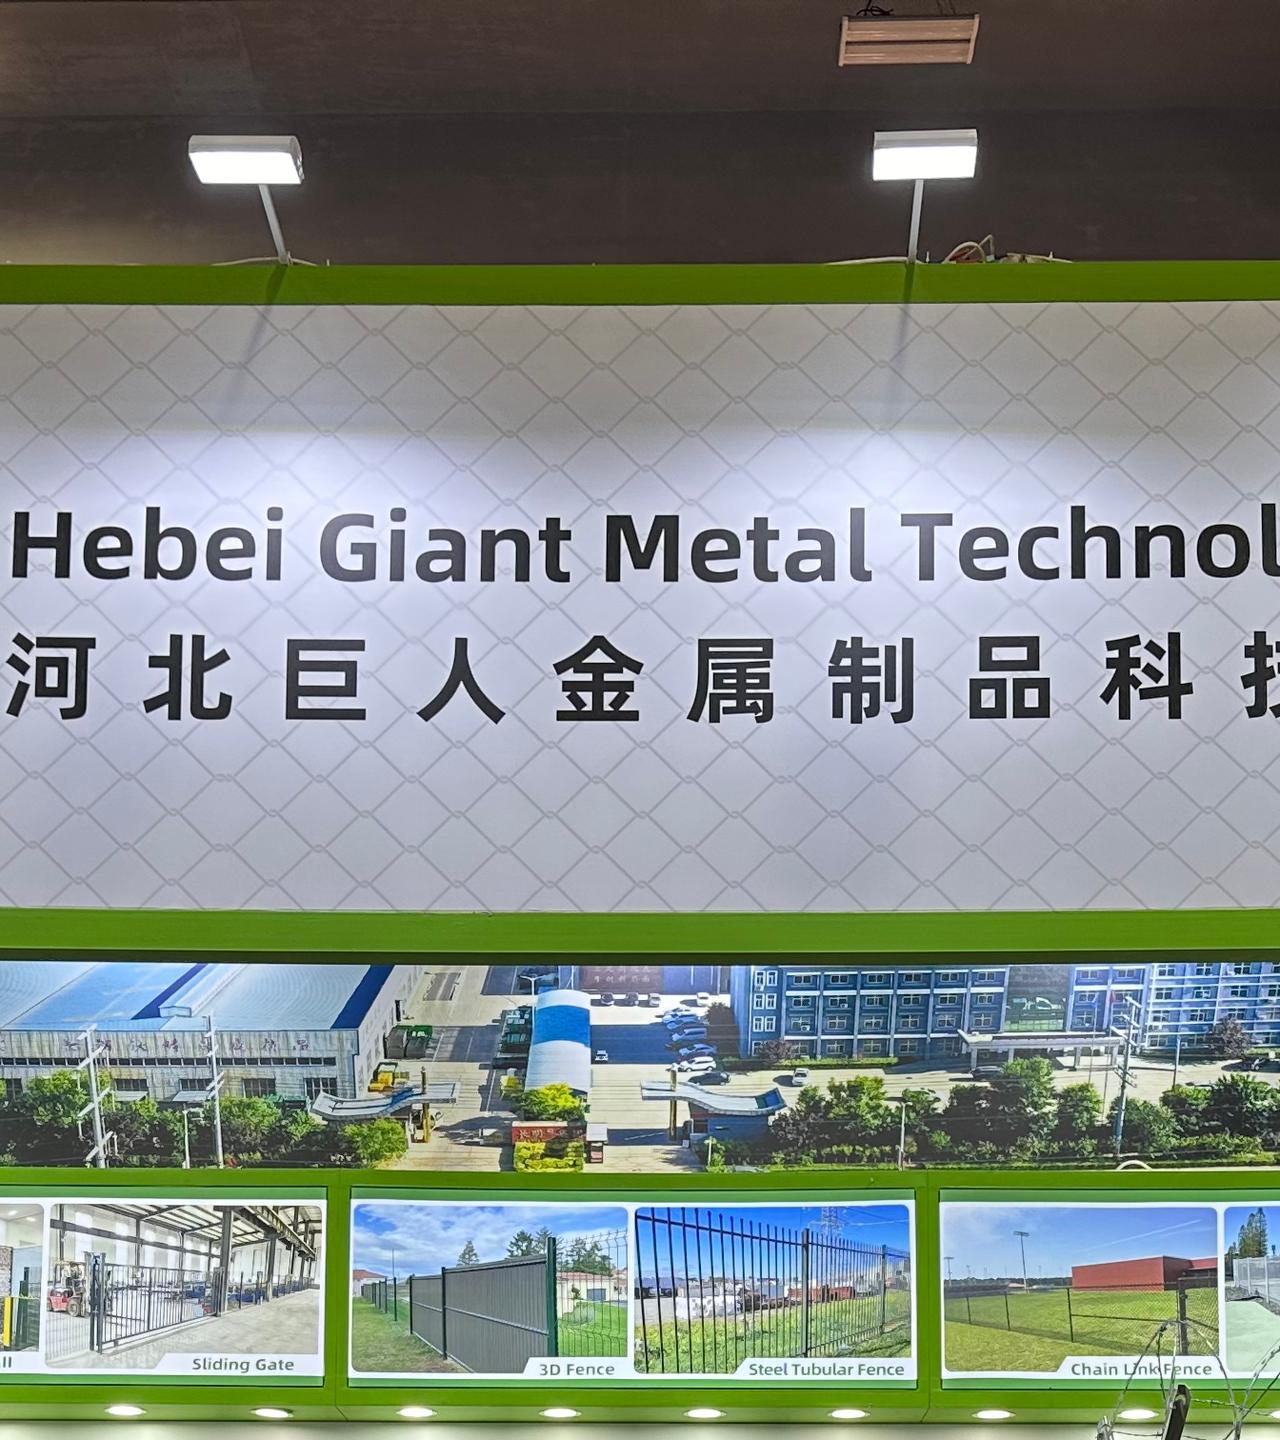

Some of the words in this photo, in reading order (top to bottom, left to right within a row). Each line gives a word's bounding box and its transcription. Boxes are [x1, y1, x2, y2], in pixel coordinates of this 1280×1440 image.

[12, 506, 283, 581] Hebei
[320, 507, 572, 583] Giant
[605, 508, 872, 583] Metal
[192, 1357, 250, 1374] Sliding
[255, 1358, 295, 1371] Gate
[539, 1363, 561, 1376] 3D
[566, 1363, 615, 1376] Fence
[749, 1362, 788, 1376] Steel
[792, 1362, 854, 1376] Tubular
[858, 1363, 905, 1376] Fence
[1071, 1363, 1118, 1376] Chain
[1124, 1362, 1161, 1376] Link
[1164, 1363, 1213, 1376] Fence
